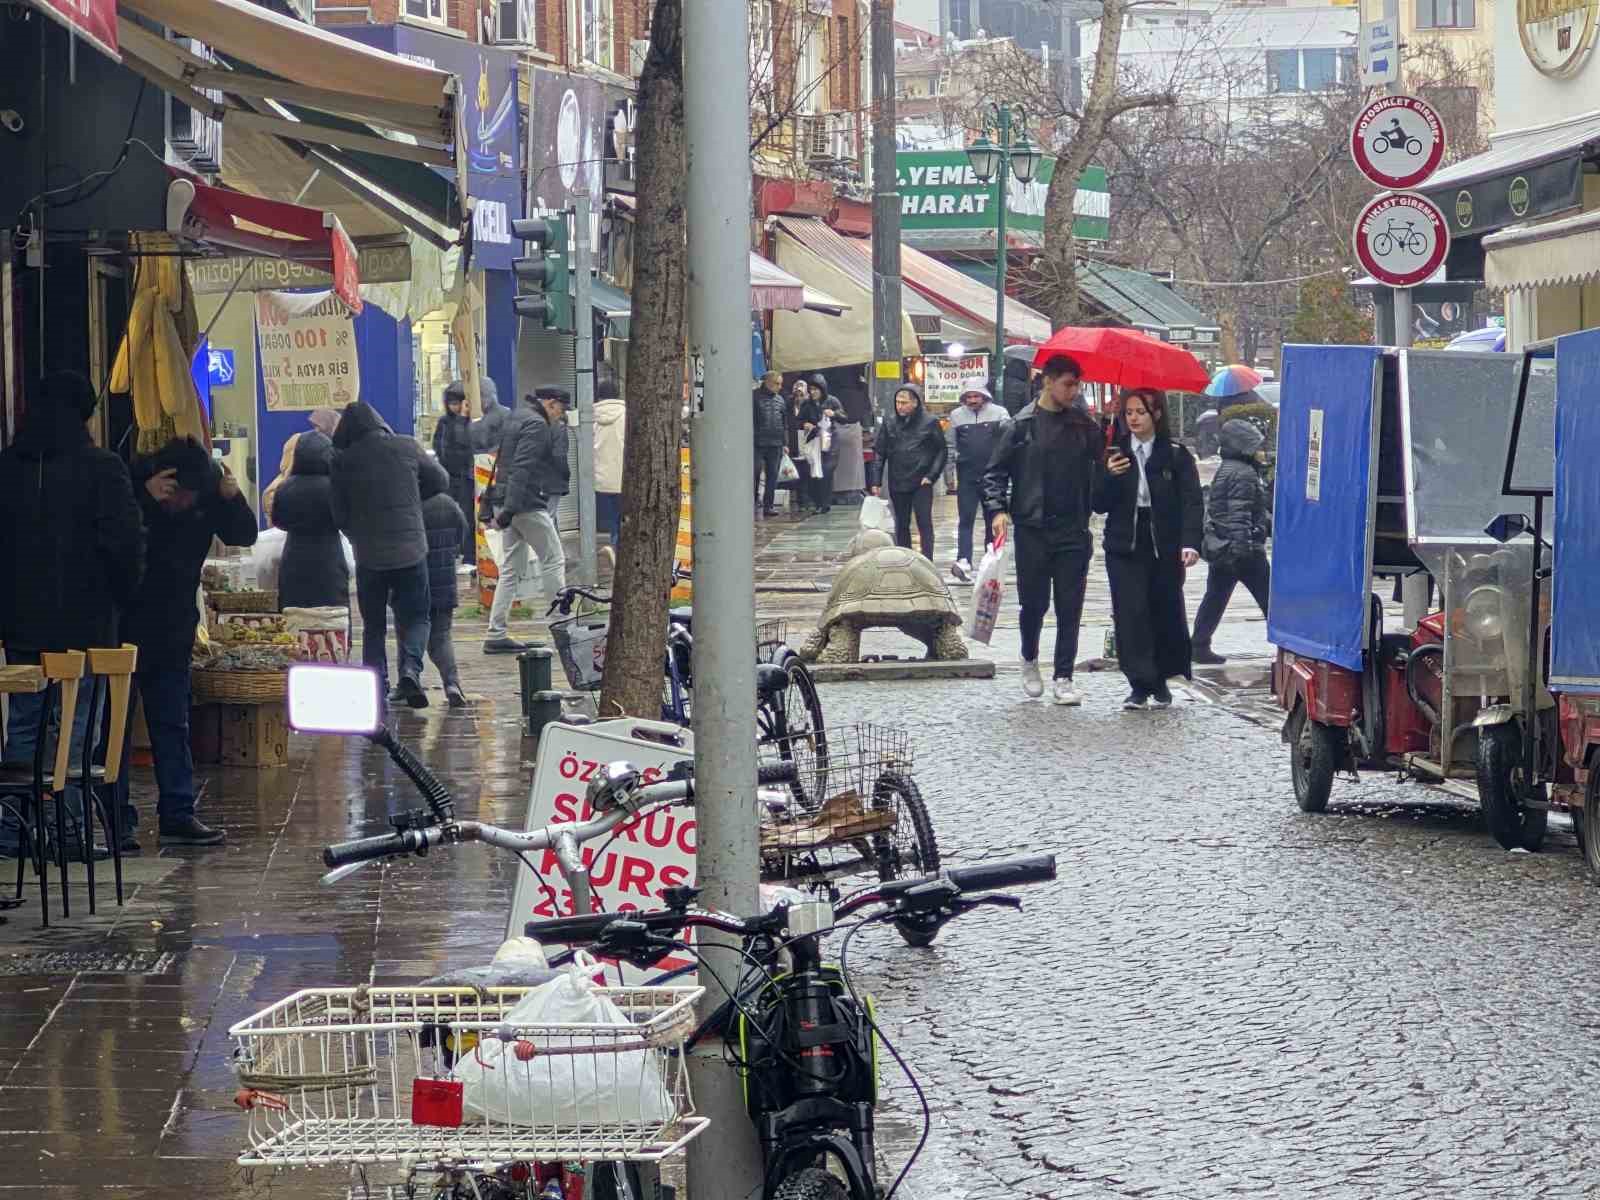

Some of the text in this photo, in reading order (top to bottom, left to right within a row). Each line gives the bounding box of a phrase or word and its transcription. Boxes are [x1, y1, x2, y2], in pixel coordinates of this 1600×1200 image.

[894, 165, 998, 186] .YEME
[901, 194, 990, 214] HARAT
[550, 792, 697, 855] SRÜC
